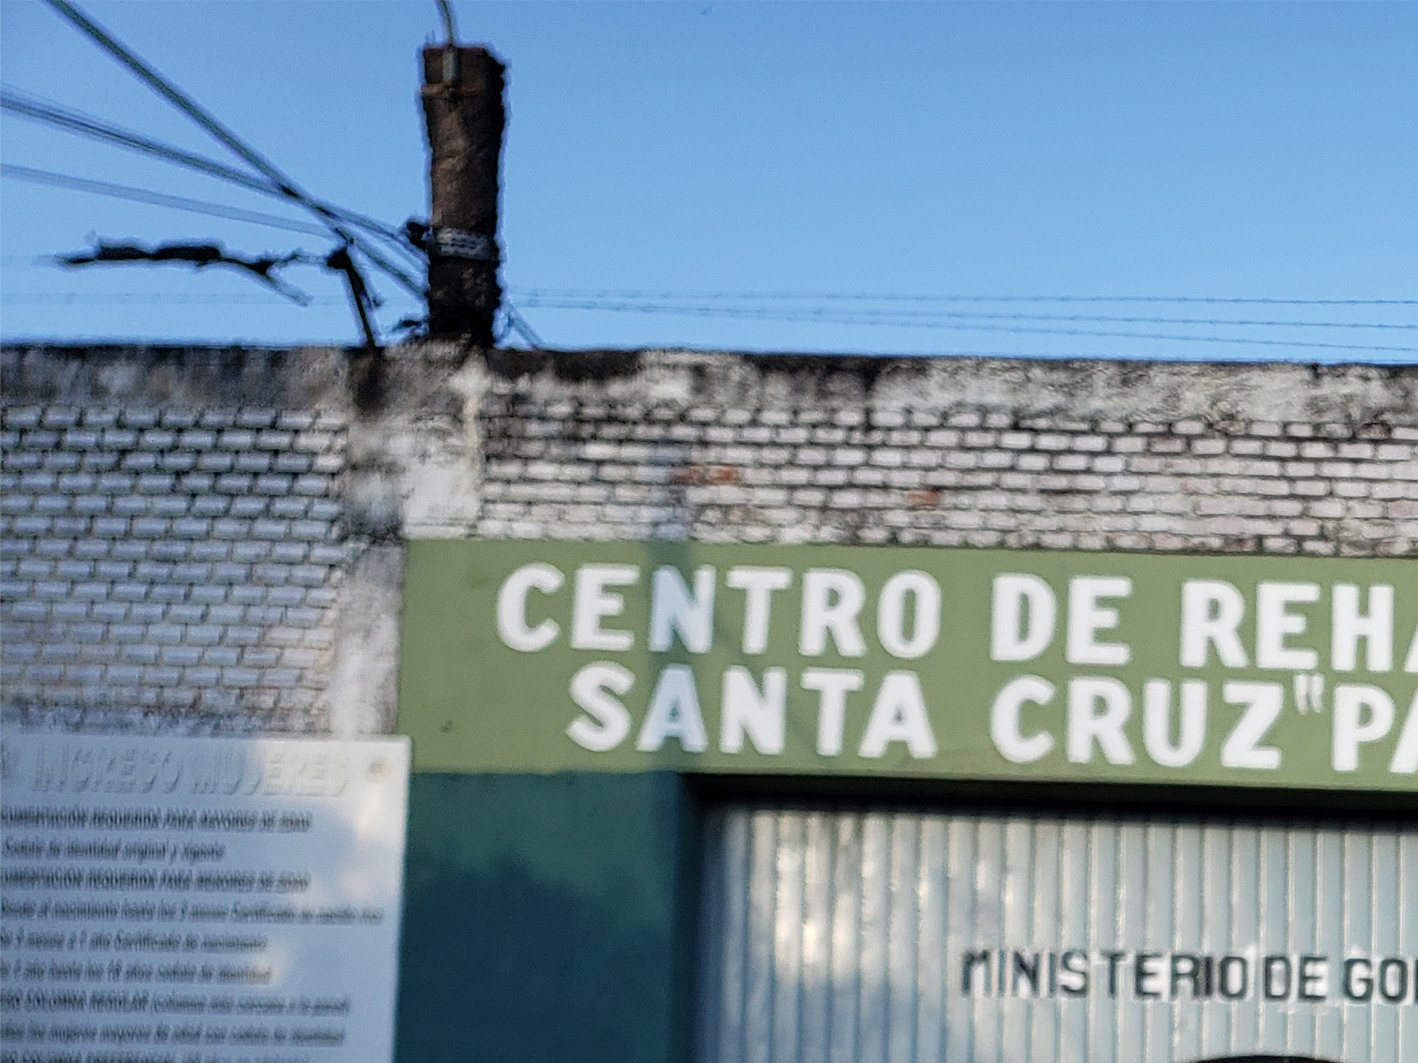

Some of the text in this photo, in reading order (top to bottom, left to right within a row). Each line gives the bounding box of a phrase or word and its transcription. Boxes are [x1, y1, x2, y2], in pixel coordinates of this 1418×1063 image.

[496, 561, 942, 660] CENTRO
[990, 571, 1134, 668] DE
[564, 661, 938, 760] SANTA
[961, 948, 1249, 1001] MINISTERIO
[1261, 954, 1328, 1002] DE
